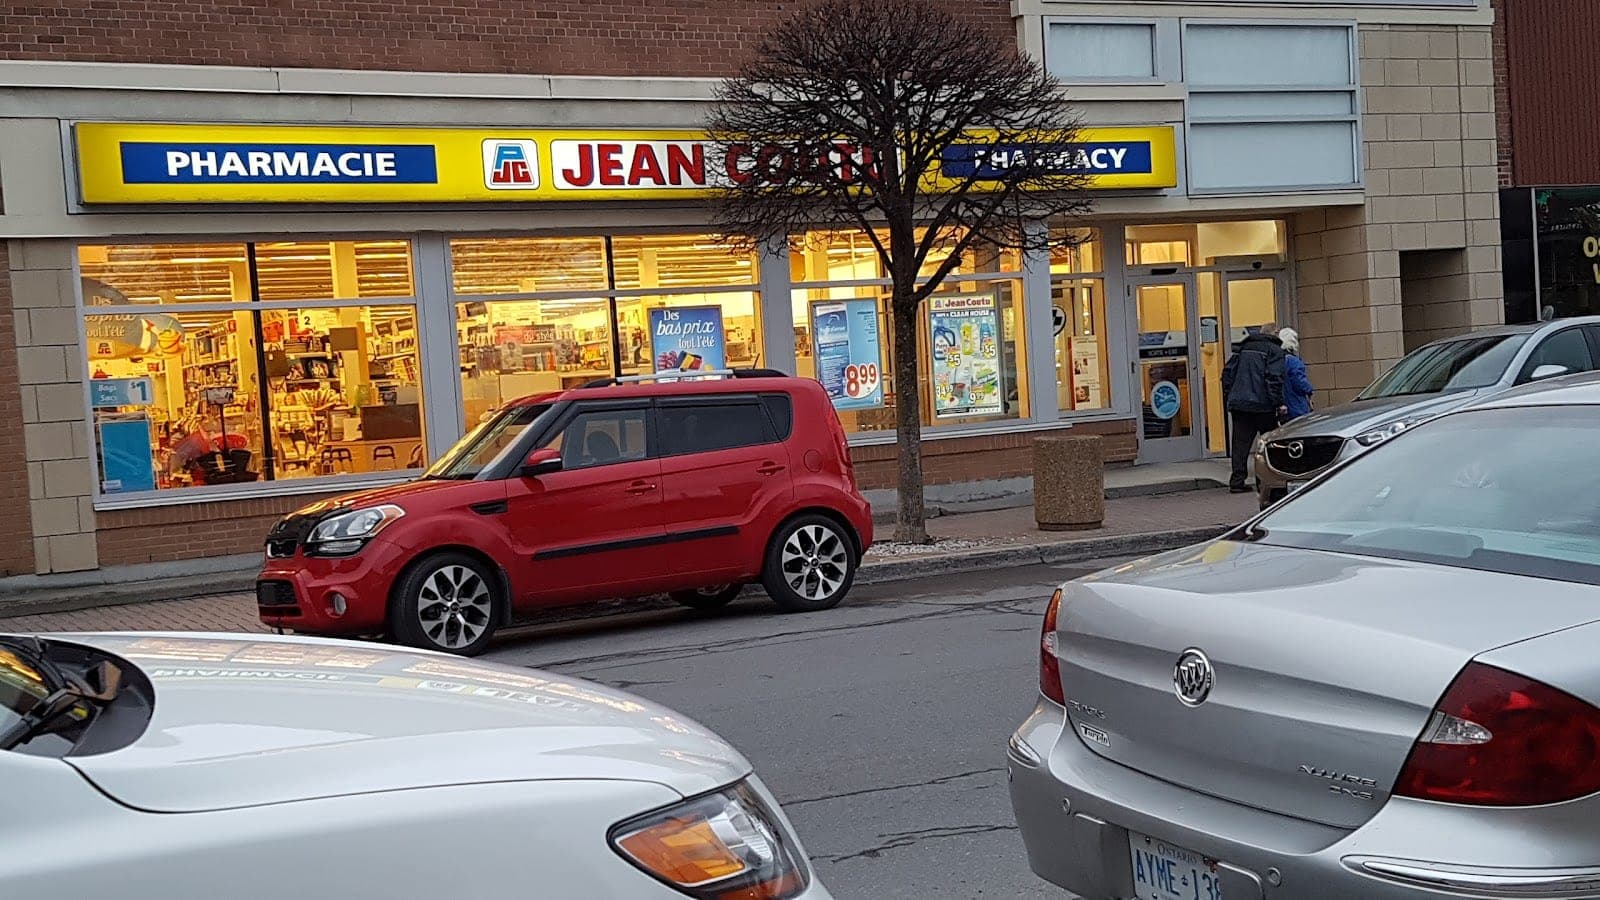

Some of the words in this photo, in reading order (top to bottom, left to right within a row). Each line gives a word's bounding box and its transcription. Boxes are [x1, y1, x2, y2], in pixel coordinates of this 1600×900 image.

[166, 150, 397, 177] PHARMACIE
[562, 143, 706, 187] JEAN
[725, 142, 890, 185] COT
[945, 299, 966, 307] Jean
[966, 297, 991, 306] Coutu
[303, 315, 311, 326] 2
[663, 310, 680, 320] Des
[656, 320, 682, 336] bas
[682, 319, 715, 338] prix
[678, 336, 696, 349] tout
[1136, 848, 1180, 896] AYME
